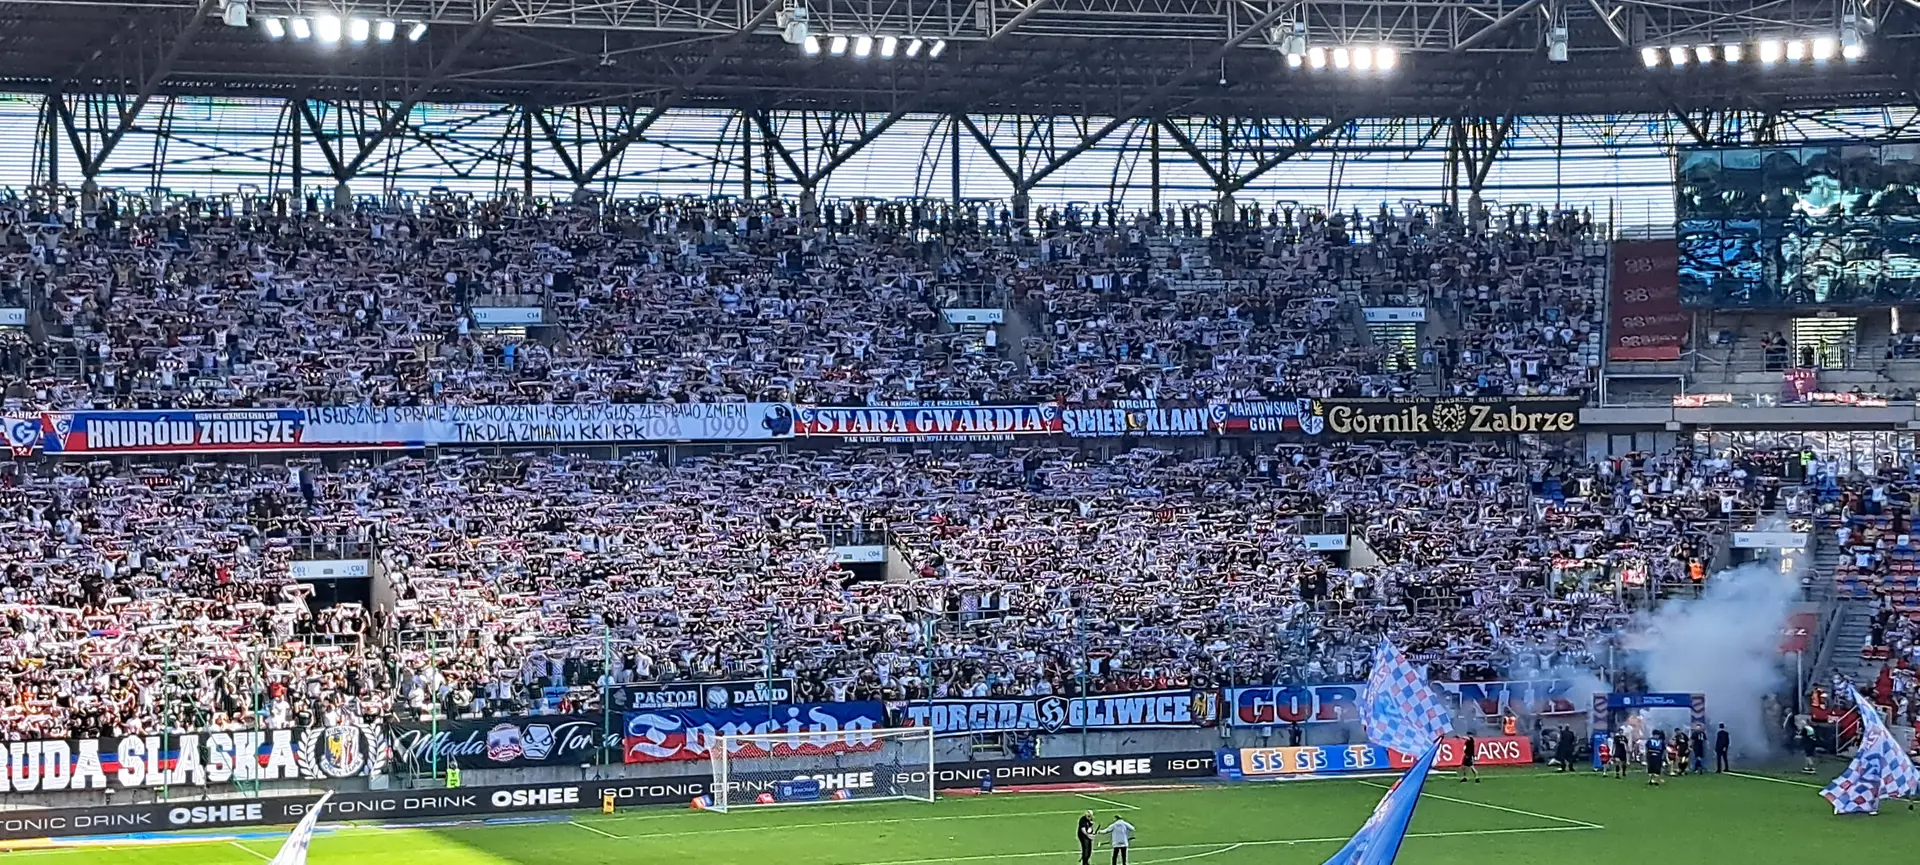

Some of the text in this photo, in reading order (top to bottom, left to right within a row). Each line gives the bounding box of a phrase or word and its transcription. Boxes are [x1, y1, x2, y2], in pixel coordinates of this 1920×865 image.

[308, 407, 321, 425] W
[394, 404, 446, 423] SPRAWIE
[705, 403, 748, 419] ZMIENI
[1112, 399, 1158, 409] TORCIDA
[1232, 401, 1297, 416] TARNOWSKIE
[816, 408, 1043, 433] STARA GWARDIA
[1328, 402, 1575, 433] Górnik Zabrze
[87, 416, 295, 448] KNURÓW ZAWSZE
[454, 422, 486, 442] TAK
[487, 422, 517, 441] DLA
[519, 423, 561, 441] ZMIAN
[612, 423, 648, 440] KPK
[633, 690, 698, 703] PASTOR
[733, 687, 788, 704] DAWID
[907, 695, 1192, 731] TORCIDA GLIWICE
[996, 764, 1061, 779] DRINK
[1073, 759, 1151, 777] OSHEE
[1168, 758, 1213, 770] ISOT
[403, 795, 477, 810] DRINK
[491, 786, 579, 808] OSHEE
[598, 783, 703, 800] ISOTONIC
[74, 812, 152, 828] DRINK
[168, 803, 263, 825] OSHEE
